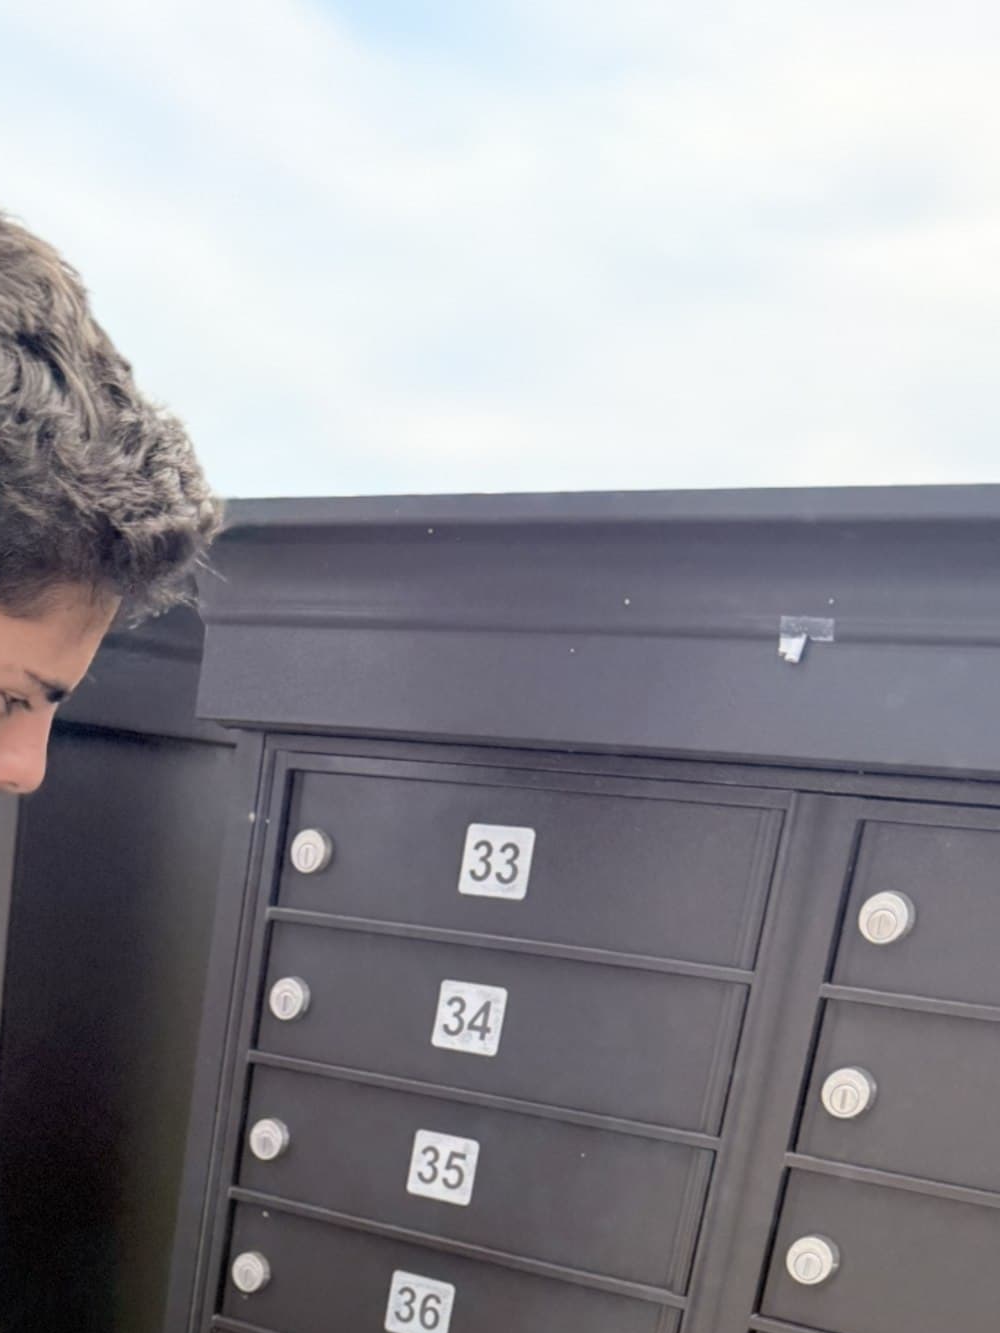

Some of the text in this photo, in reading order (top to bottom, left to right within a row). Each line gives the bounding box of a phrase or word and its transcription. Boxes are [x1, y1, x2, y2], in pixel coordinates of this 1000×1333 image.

[469, 839, 520, 885] 33
[442, 996, 492, 1041] 34
[417, 1146, 467, 1190] 35
[394, 1286, 441, 1330] 36
